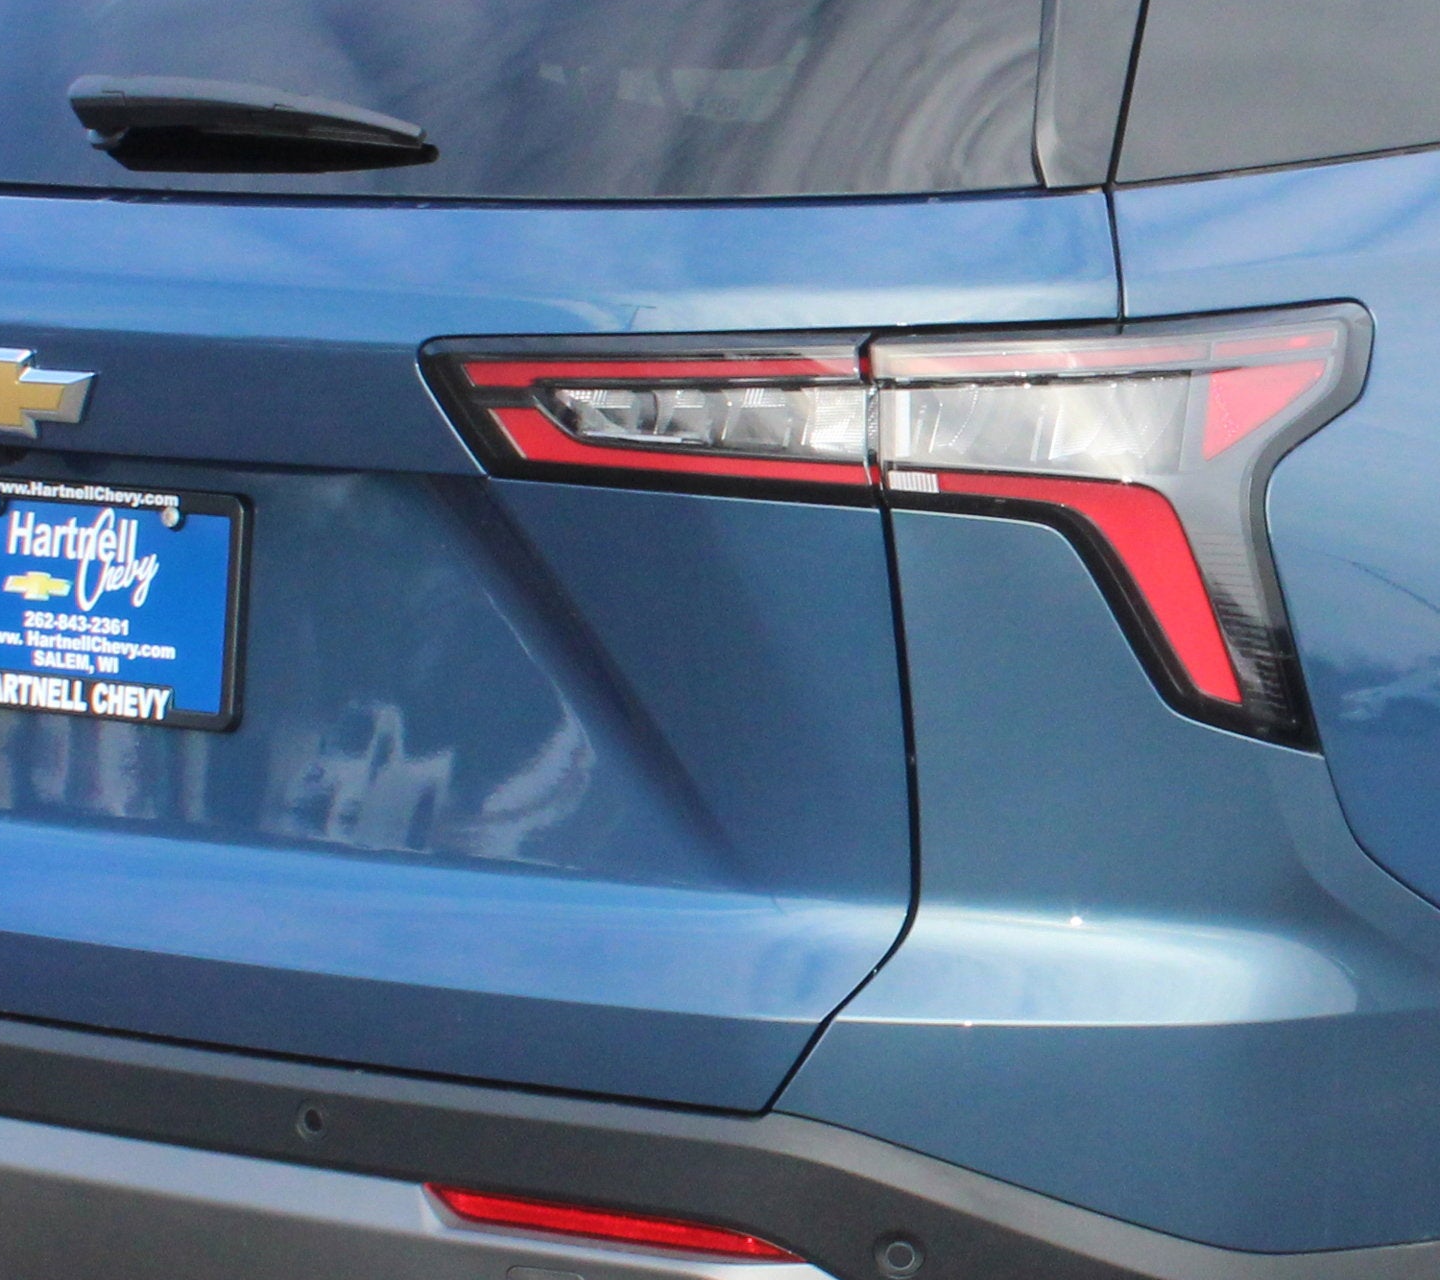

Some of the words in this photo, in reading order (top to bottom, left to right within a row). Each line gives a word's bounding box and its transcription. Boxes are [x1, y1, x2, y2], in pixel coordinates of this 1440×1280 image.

[7, 510, 139, 564] Hartnell
[23, 611, 129, 636] 262-843-2361
[27, 633, 176, 660] HartnellChevy.com
[33, 650, 95, 674] SALEM,
[97, 656, 120, 673] WI
[91, 685, 171, 720] CHEVY
